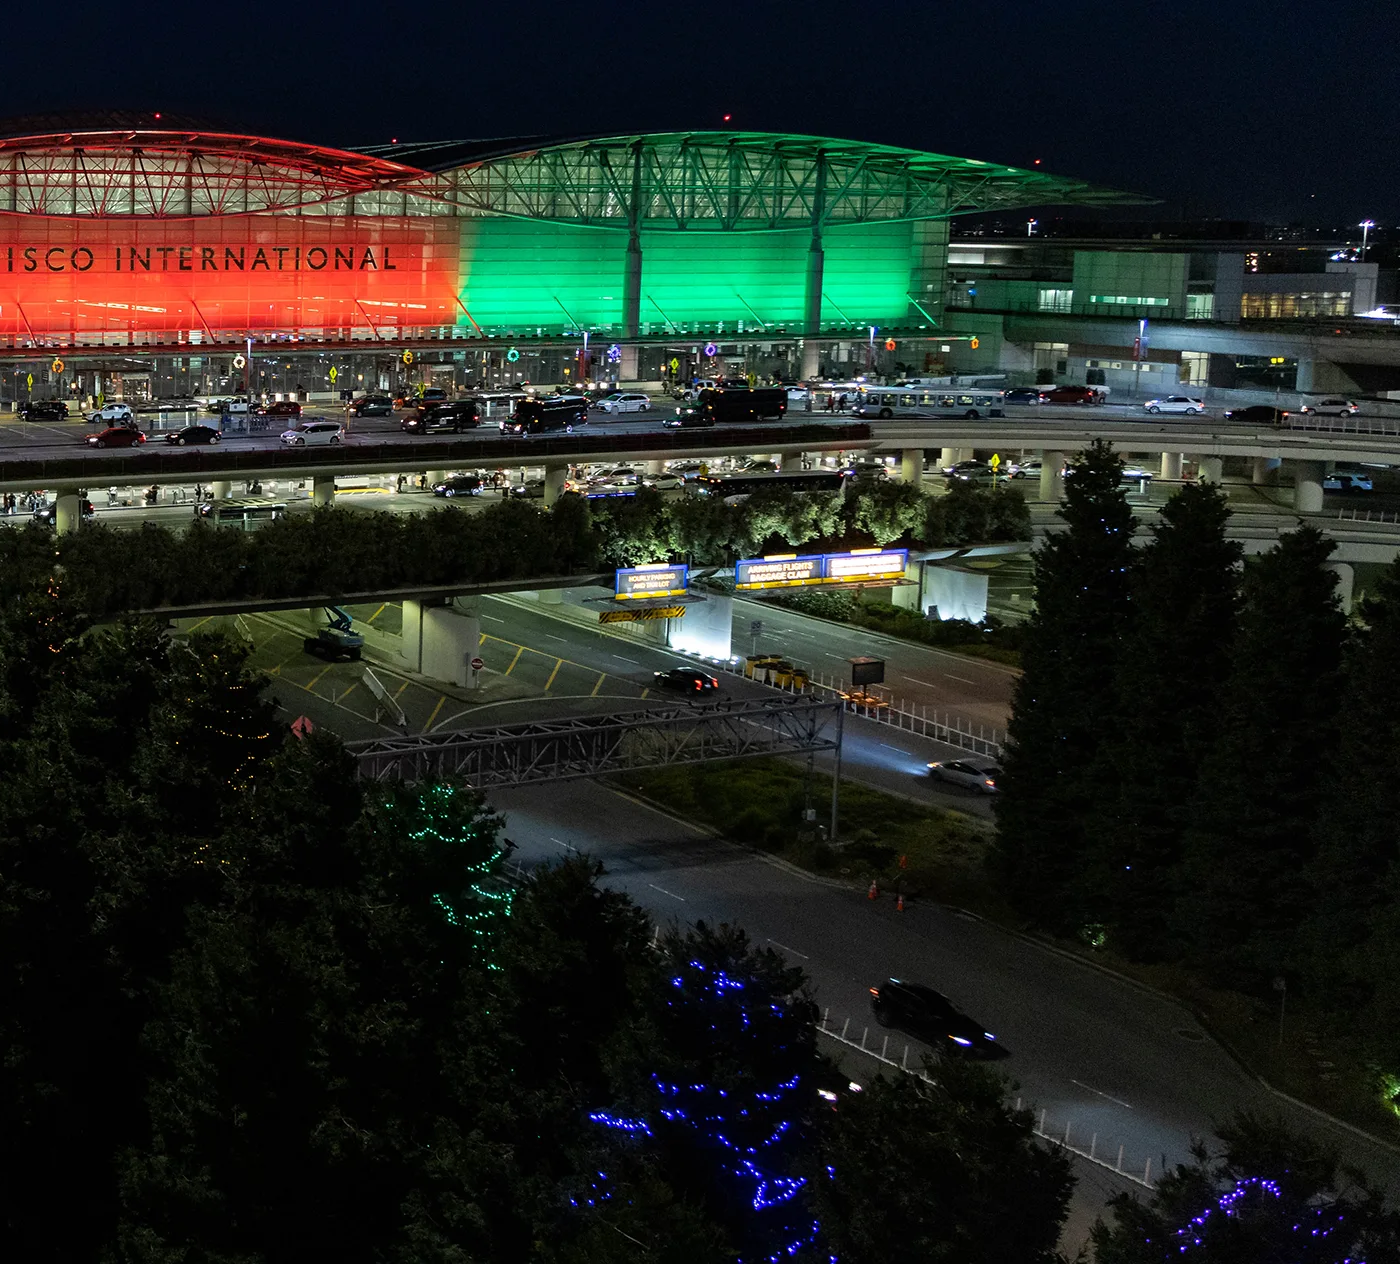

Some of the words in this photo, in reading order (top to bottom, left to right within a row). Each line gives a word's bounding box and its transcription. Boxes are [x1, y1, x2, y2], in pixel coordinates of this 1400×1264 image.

[116, 246, 397, 271] INTERNATIONAL
[748, 564, 782, 574] ARRIVING
[783, 562, 814, 571] FLIGHTS
[750, 572, 786, 582] BAGGAGE
[787, 570, 811, 579] CLAIM
